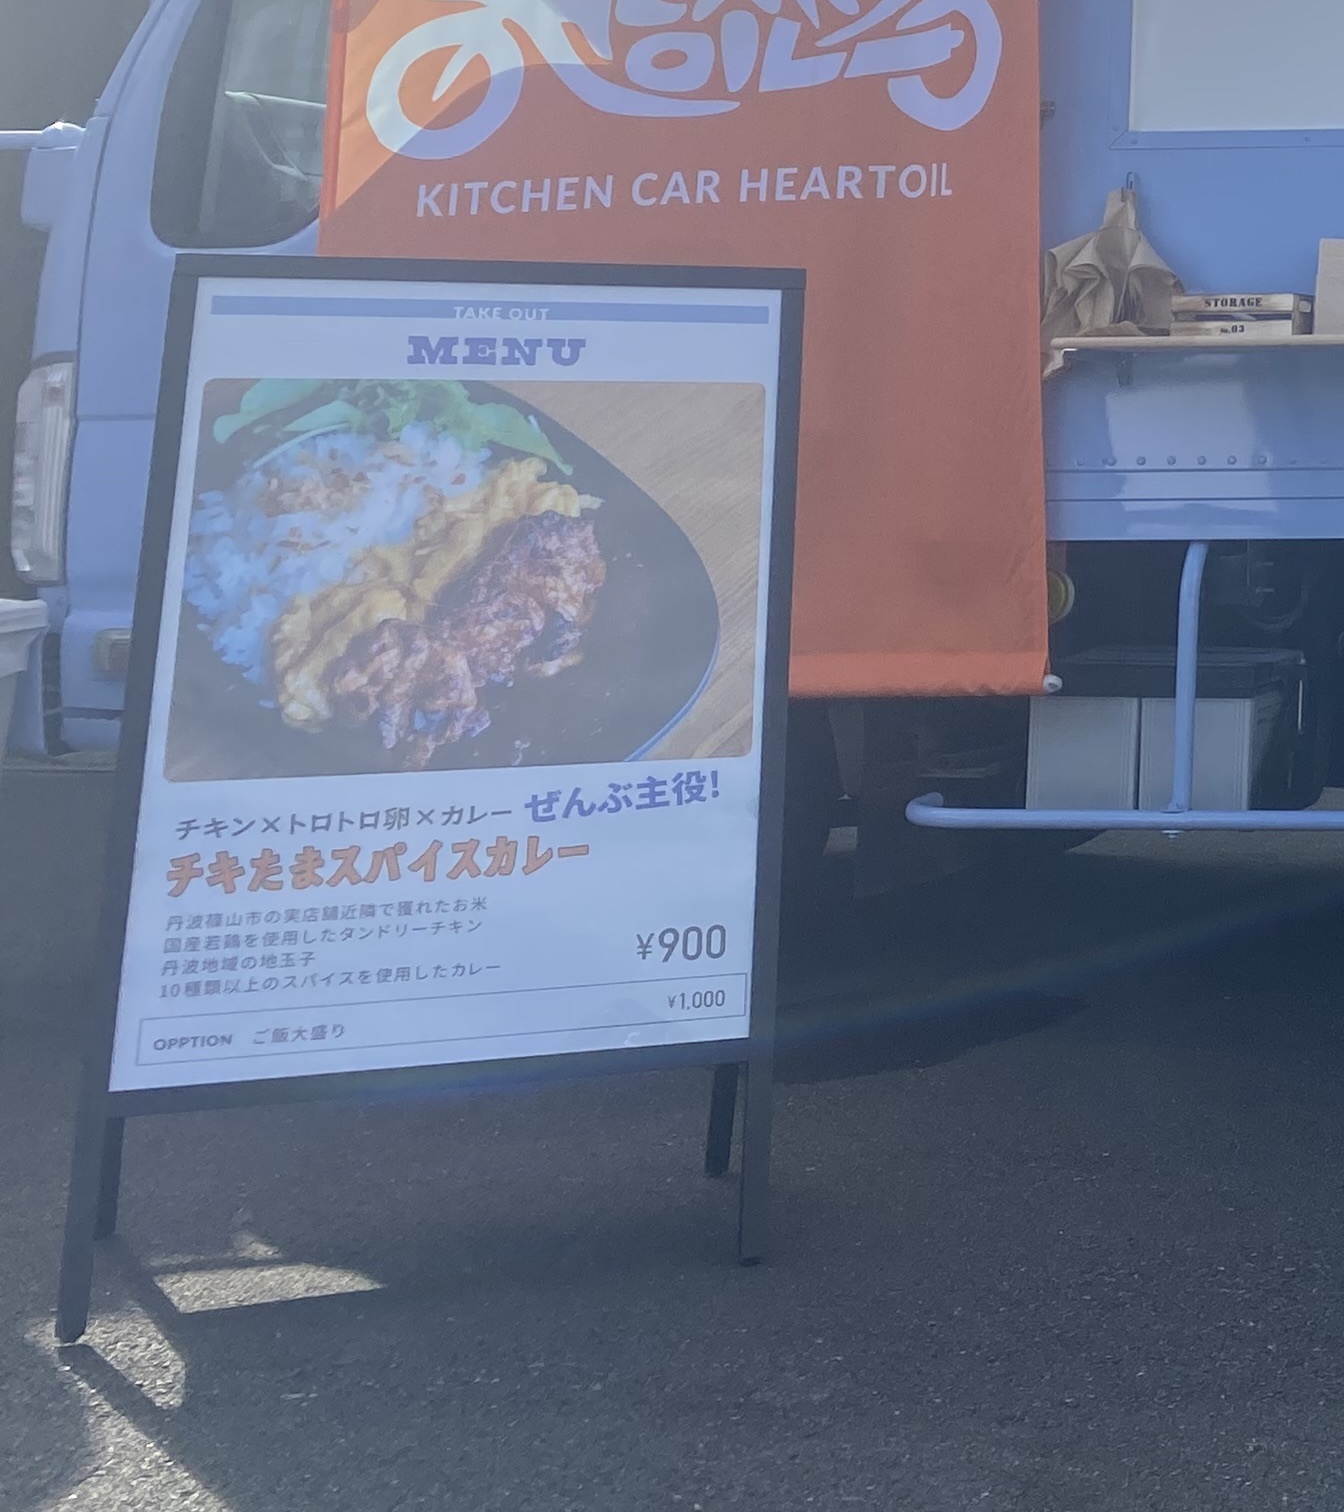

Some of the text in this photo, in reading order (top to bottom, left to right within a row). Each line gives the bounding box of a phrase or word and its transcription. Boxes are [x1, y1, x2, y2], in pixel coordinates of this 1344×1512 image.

[416, 163, 952, 218] KITCHEN CAR HEARTOIL
[453, 306, 550, 321] TAKE OUT
[1204, 297, 1263, 308] STORAGE
[407, 335, 586, 367] MENU
[524, 770, 720, 824] ぜんぶ主役!
[166, 835, 590, 898] チキたまスパイスカレー
[636, 924, 726, 963] ¥900
[668, 990, 726, 1010] ¥1,000
[153, 1023, 347, 1052] OPPTION ご飯大盛り
